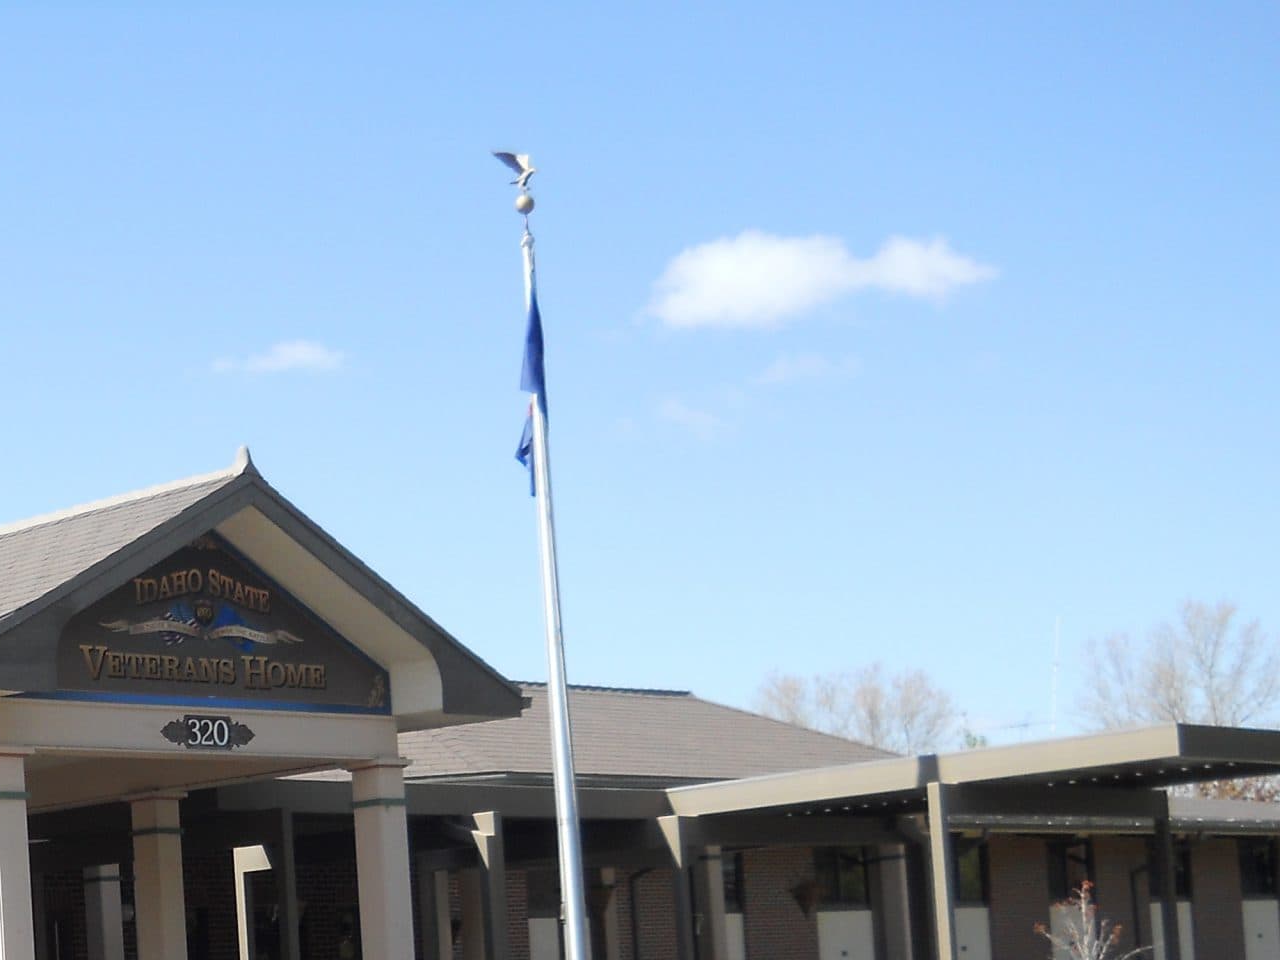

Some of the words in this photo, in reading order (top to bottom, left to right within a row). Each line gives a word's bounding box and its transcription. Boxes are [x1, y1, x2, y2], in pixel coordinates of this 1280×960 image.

[134, 569, 202, 603] IDAHO
[208, 568, 270, 612] STATE
[80, 645, 236, 684] VETERANS
[241, 656, 326, 689] HOME
[187, 718, 229, 746] 320
